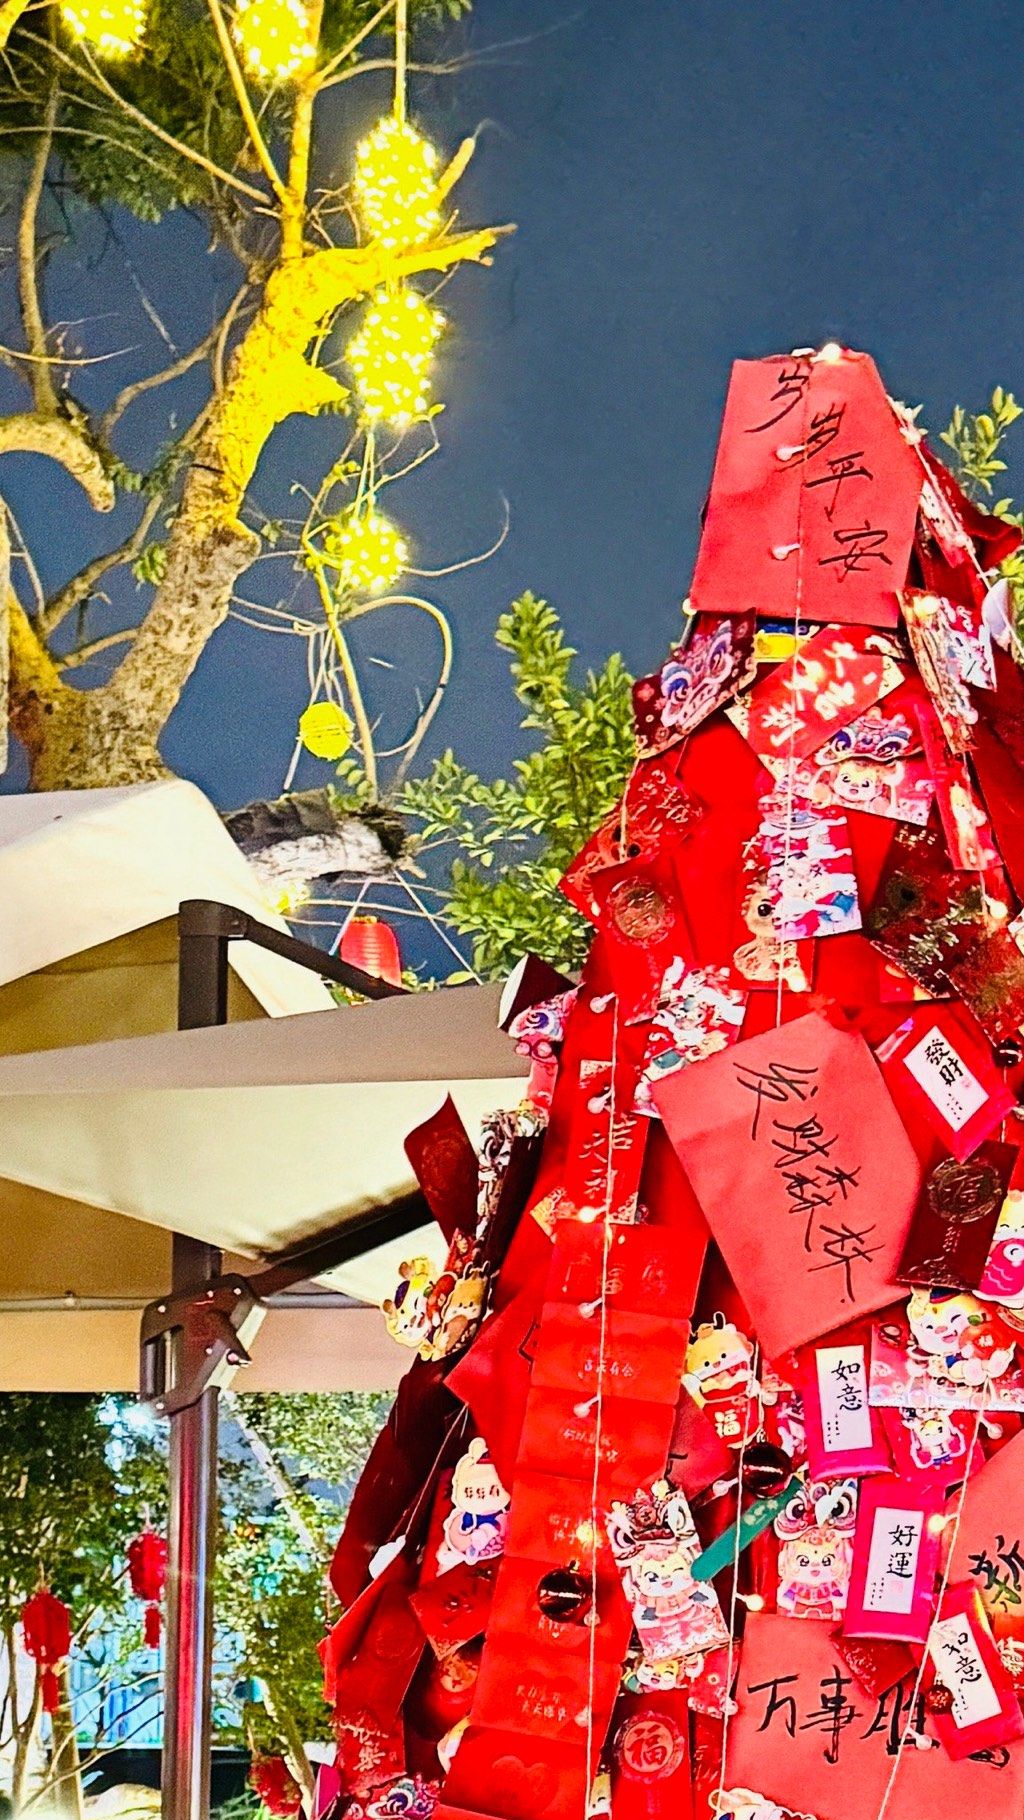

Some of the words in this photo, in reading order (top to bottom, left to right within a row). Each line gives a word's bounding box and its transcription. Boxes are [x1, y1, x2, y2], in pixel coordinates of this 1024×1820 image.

[744, 366, 893, 583] 岁岁平安
[924, 1037, 964, 1086] 發財
[830, 1359, 863, 1413] 如意
[885, 1524, 920, 1580] 好運
[941, 1631, 983, 1685] 如意
[625, 1723, 669, 1769] 福
